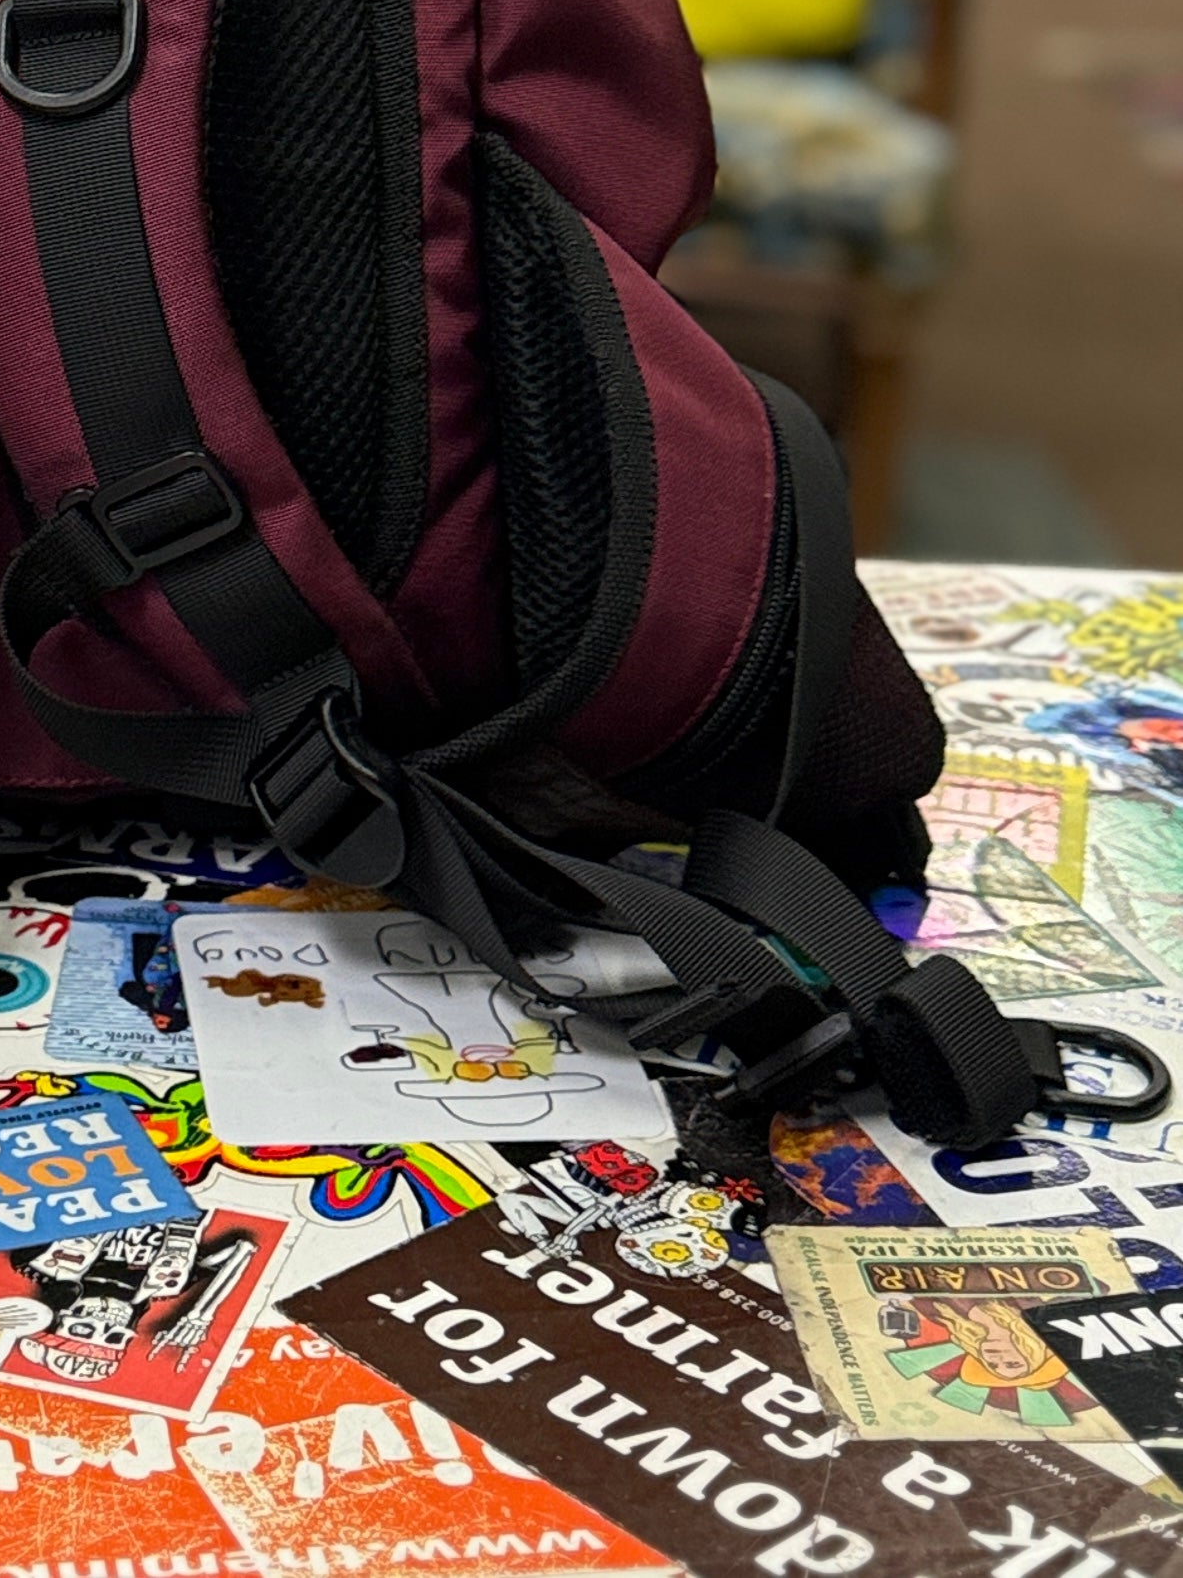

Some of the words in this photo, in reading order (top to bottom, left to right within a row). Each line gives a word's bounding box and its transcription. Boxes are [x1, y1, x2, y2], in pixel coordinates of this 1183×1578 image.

[192, 929, 330, 967] Doug
[848, 1244, 898, 1259] IPA
[909, 1244, 1079, 1259] MILKSHAKE
[986, 1265, 1081, 1292] ON
[367, 1280, 556, 1385] for
[54, 1353, 112, 1379] DEAD
[816, 1285, 858, 1374] INDEPENDENCE
[844, 1370, 880, 1428] MATTERS
[546, 1375, 876, 1578] down
[881, 1450, 972, 1511] a
